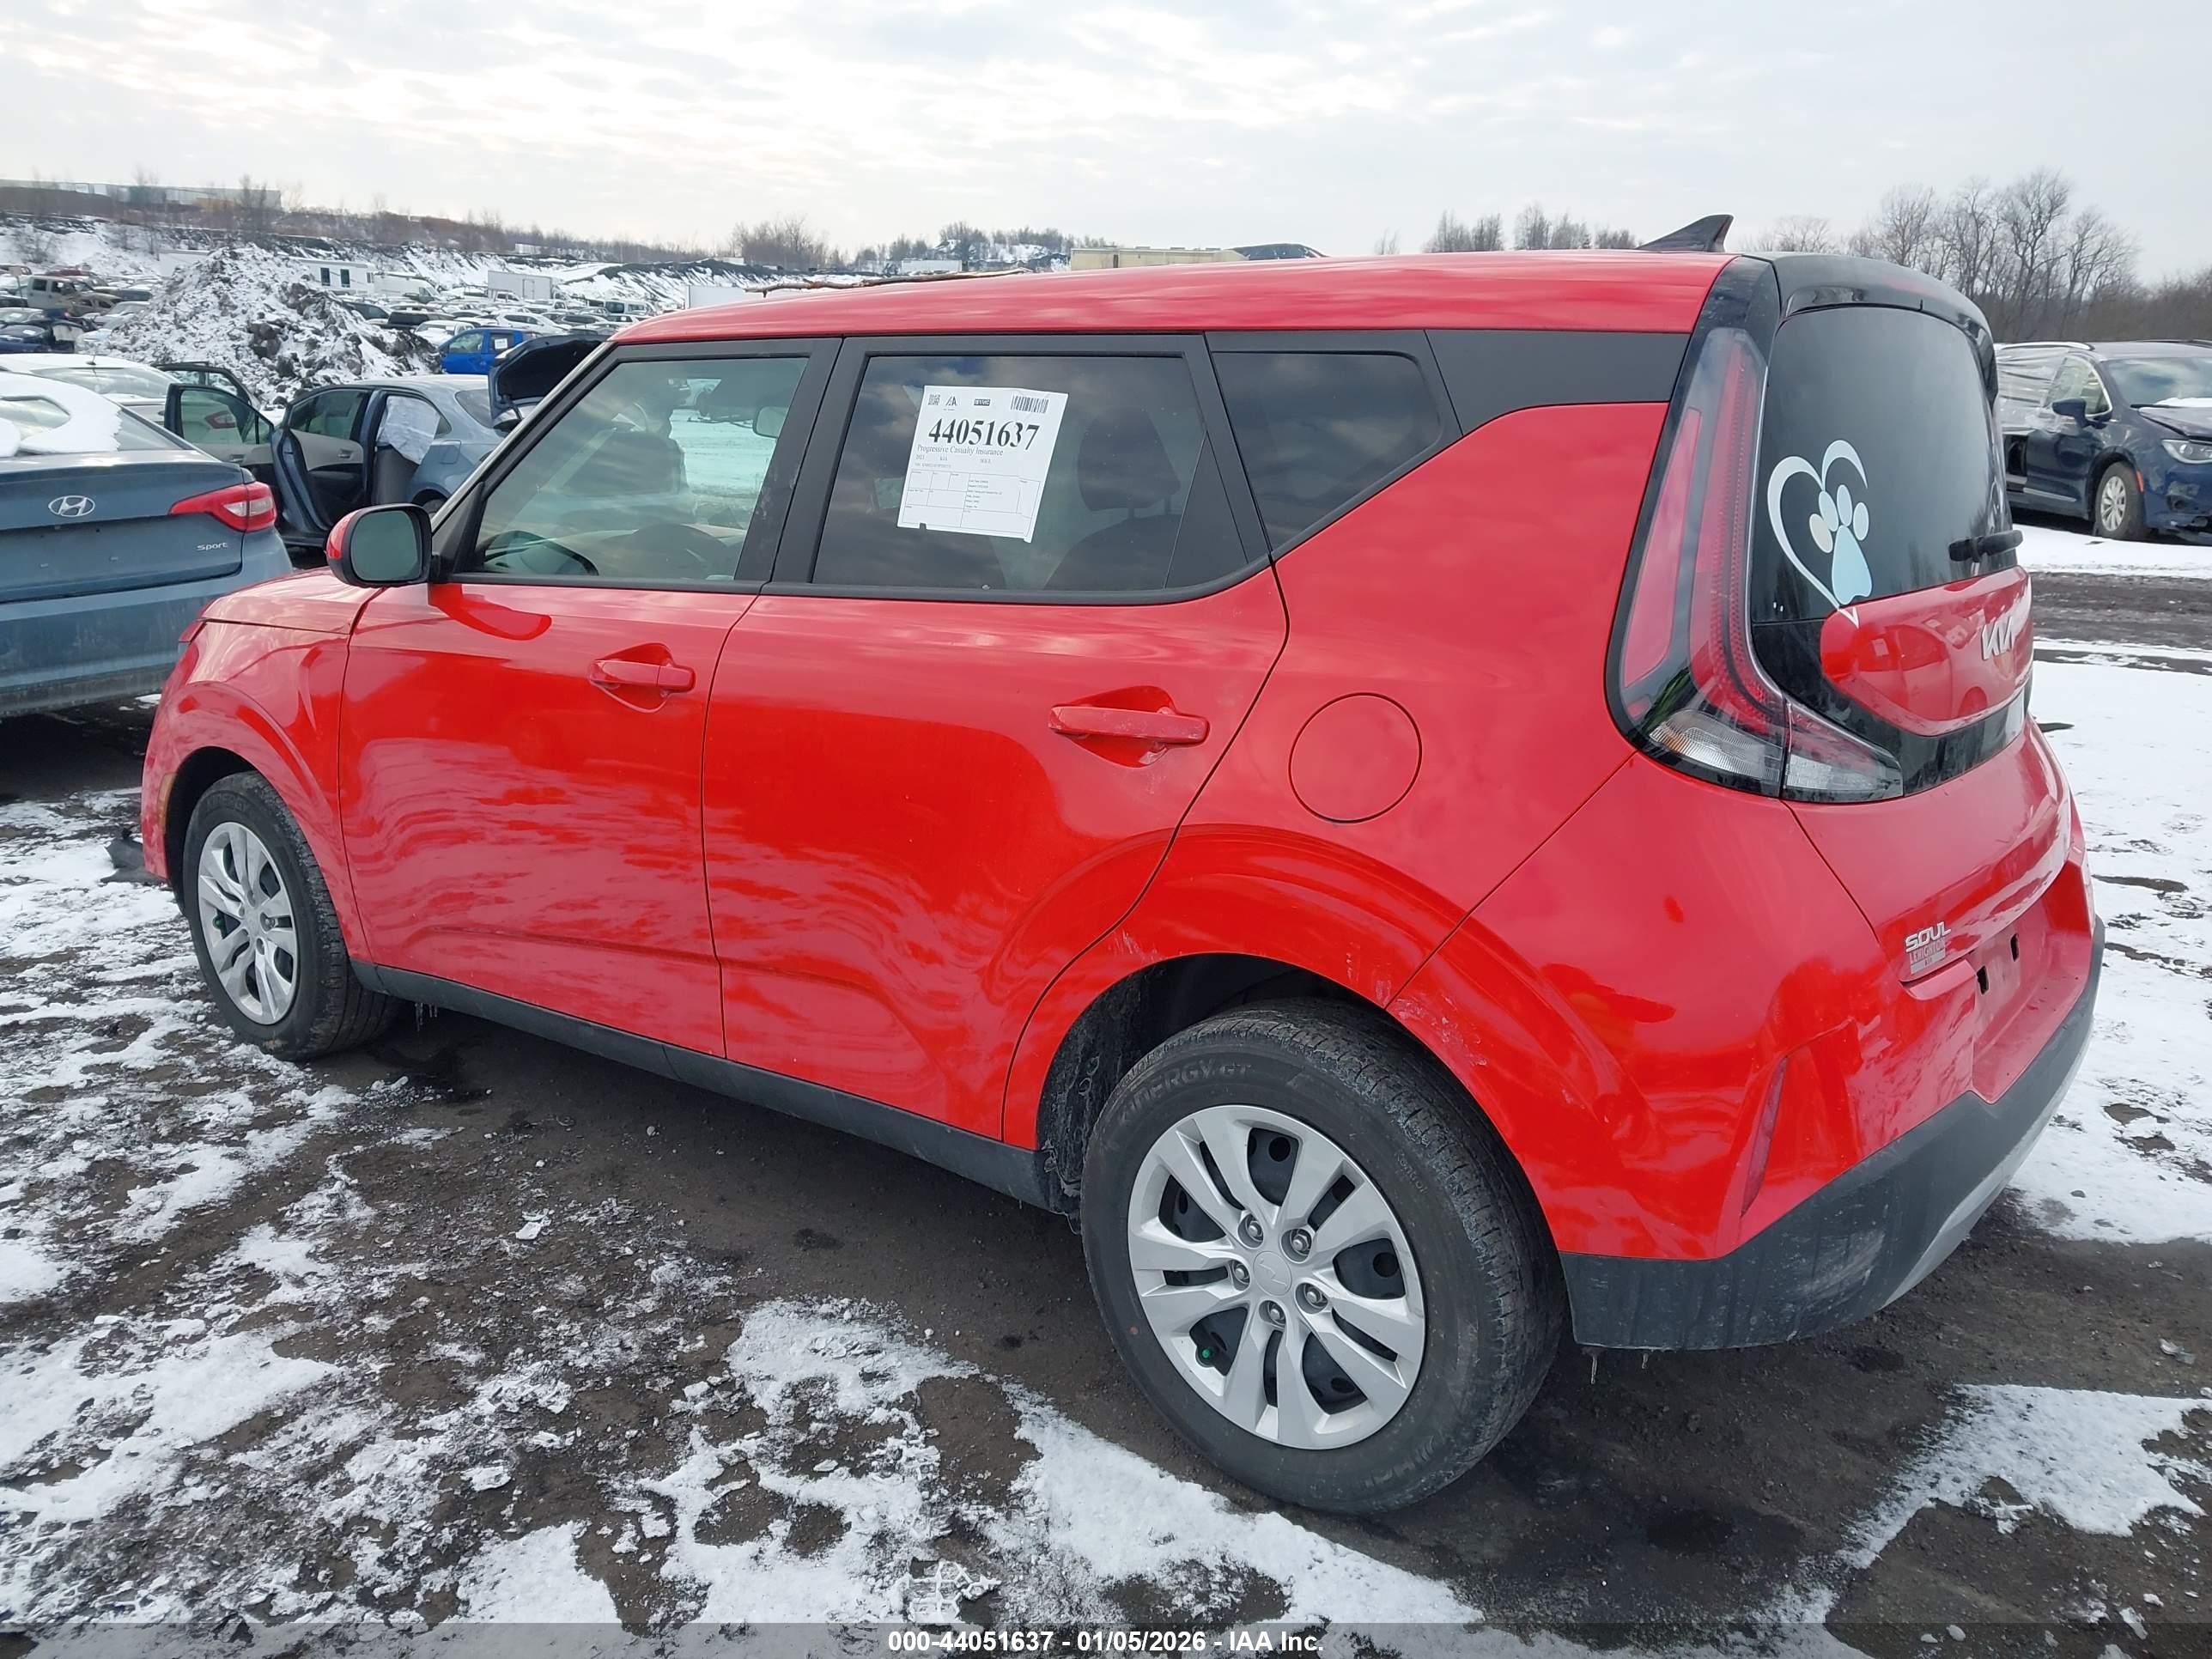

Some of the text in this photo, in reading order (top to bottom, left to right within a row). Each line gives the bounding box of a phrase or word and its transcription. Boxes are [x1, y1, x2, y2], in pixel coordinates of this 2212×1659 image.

[917, 444, 1004, 456] Progressive Casualty Insurance
[928, 418, 1040, 451] 44051637
[1905, 921, 1952, 952] SOUL
